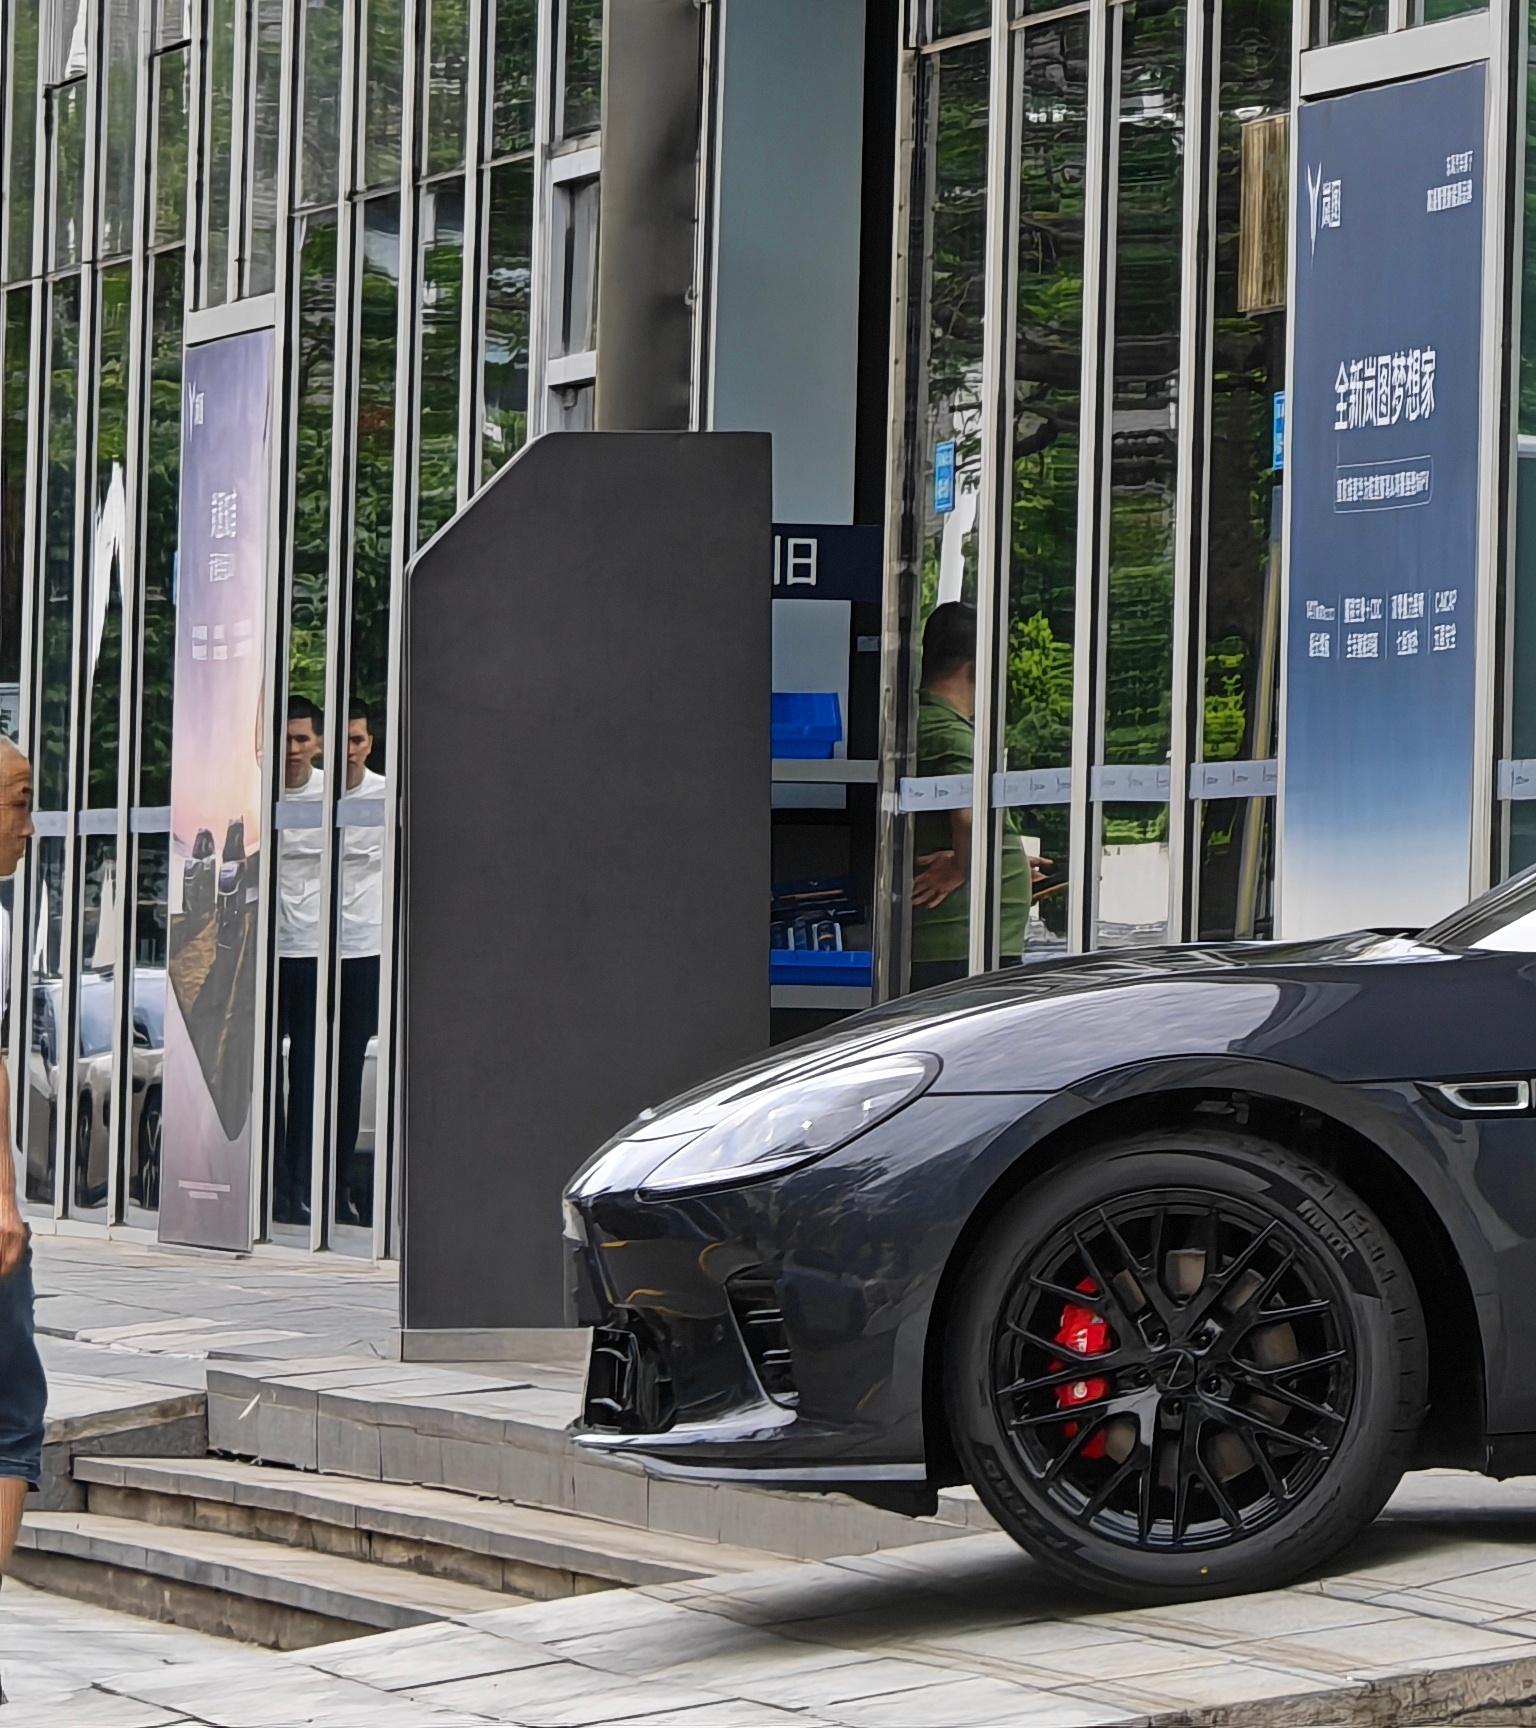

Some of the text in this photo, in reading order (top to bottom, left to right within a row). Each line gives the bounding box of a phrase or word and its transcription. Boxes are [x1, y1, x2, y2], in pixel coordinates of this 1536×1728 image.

[1334, 345, 1436, 431] 全新岚图梦想家
